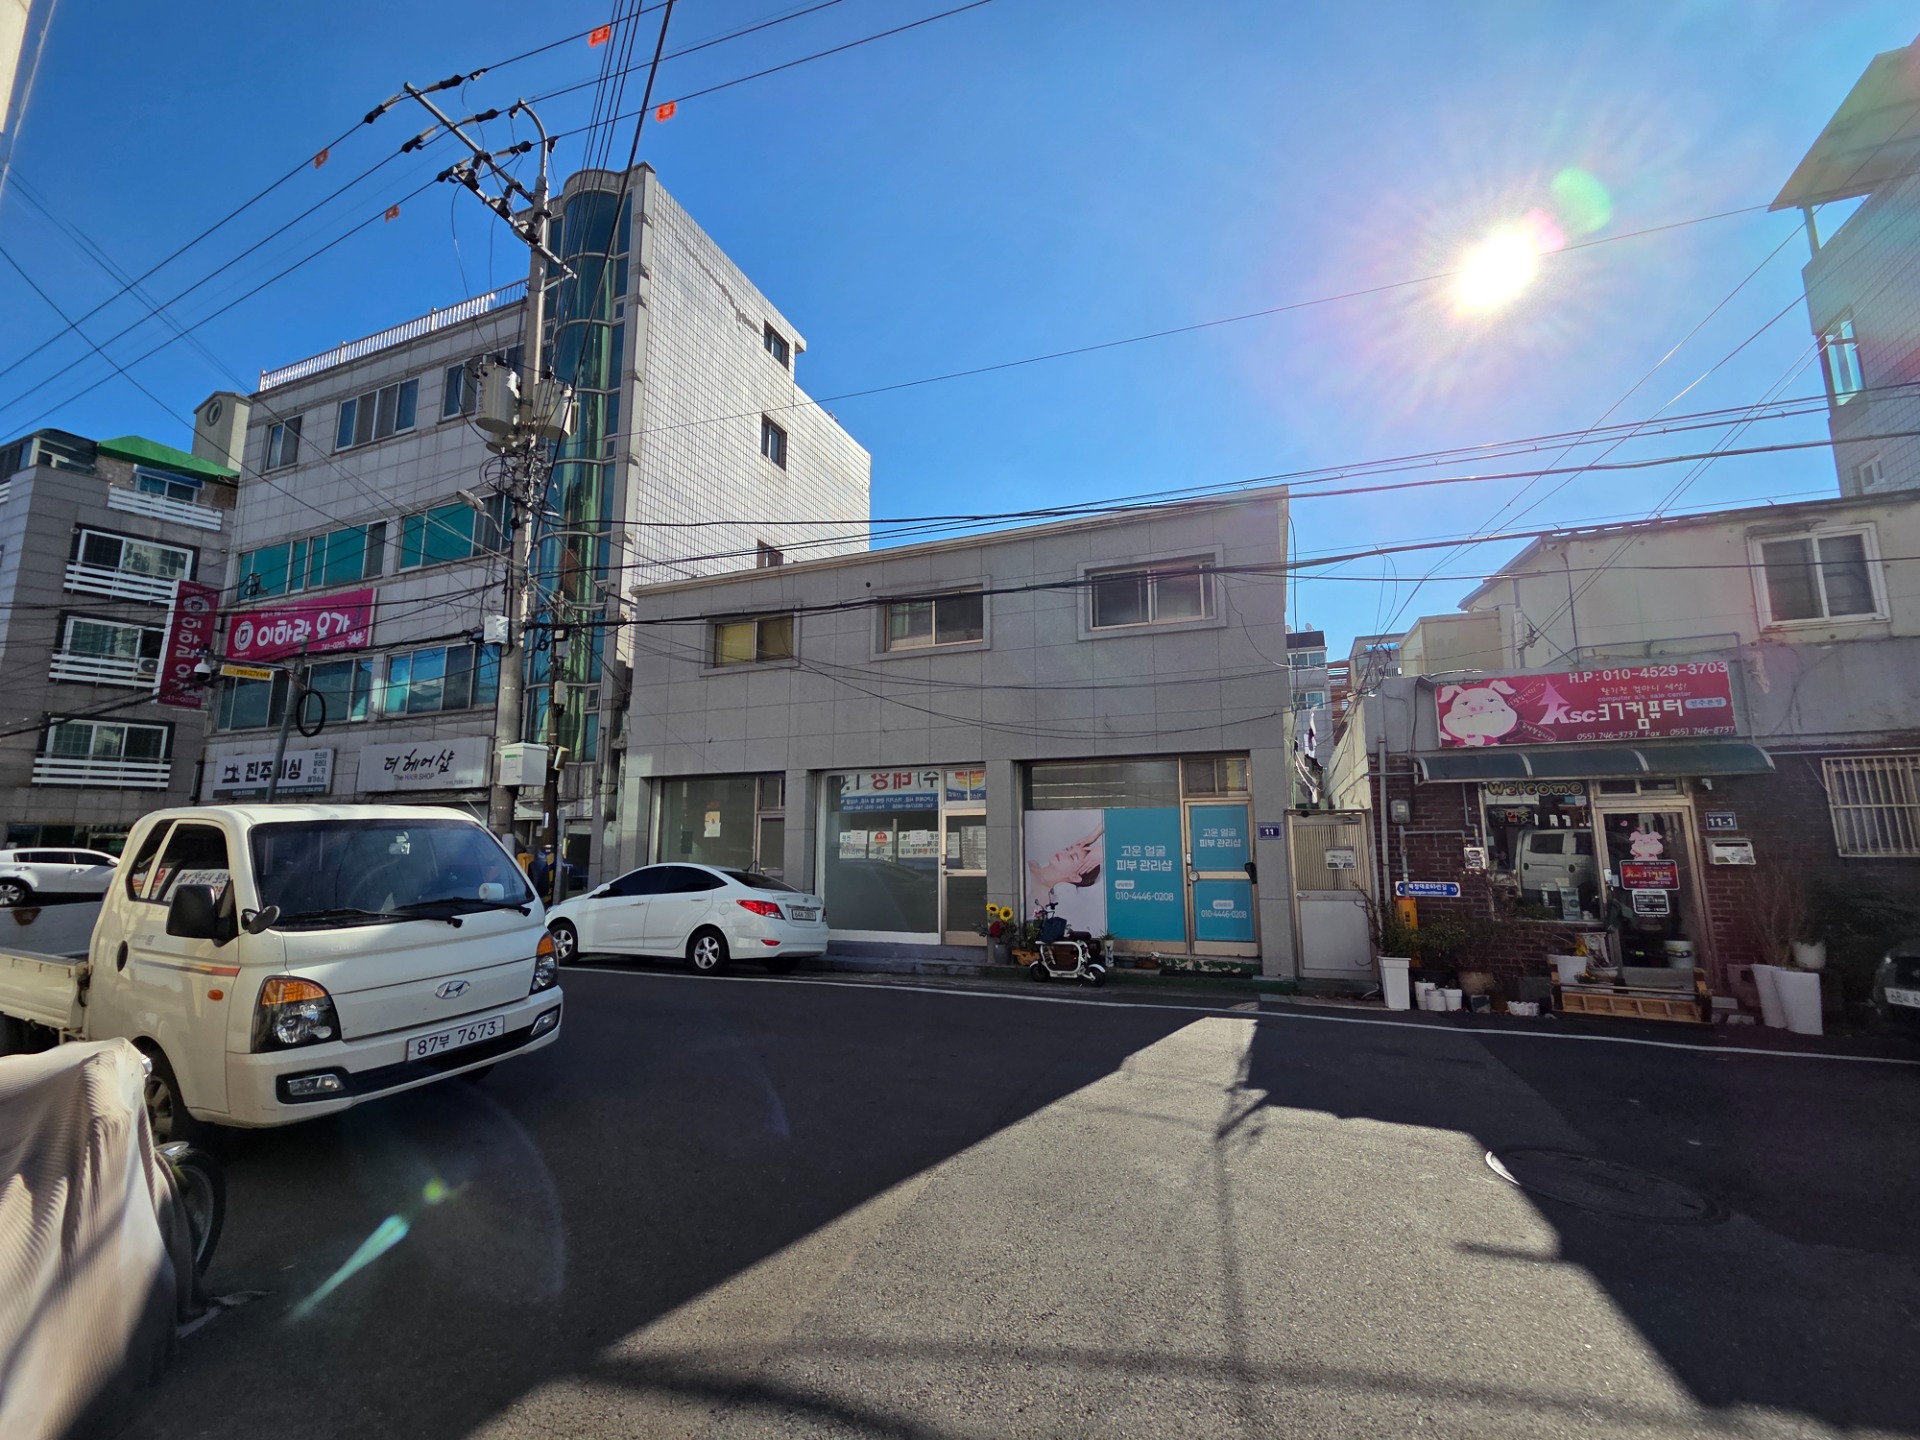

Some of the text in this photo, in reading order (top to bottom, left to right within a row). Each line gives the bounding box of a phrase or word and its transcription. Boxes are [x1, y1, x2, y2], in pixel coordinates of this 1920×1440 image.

[257, 618, 312, 647] 이하라
[316, 611, 351, 640] 요가
[245, 758, 303, 782] 진주싱
[418, 772, 435, 780] SHOP
[1487, 782, 1584, 796] Welcome
[1708, 818, 1734, 826] 11-1
[1202, 828, 1237, 837] 고운 얼굴
[1265, 828, 1274, 836] 11
[1200, 838, 1241, 848] 피부 관리샵
[1121, 846, 1166, 857] 고운 얼굴
[1116, 860, 1173, 872] 피부 관리샵
[1115, 891, 1174, 901] 010-4446-0208
[1200, 910, 1247, 919] 010-4446-0208
[418, 1021, 497, 1056] 87부 7673
